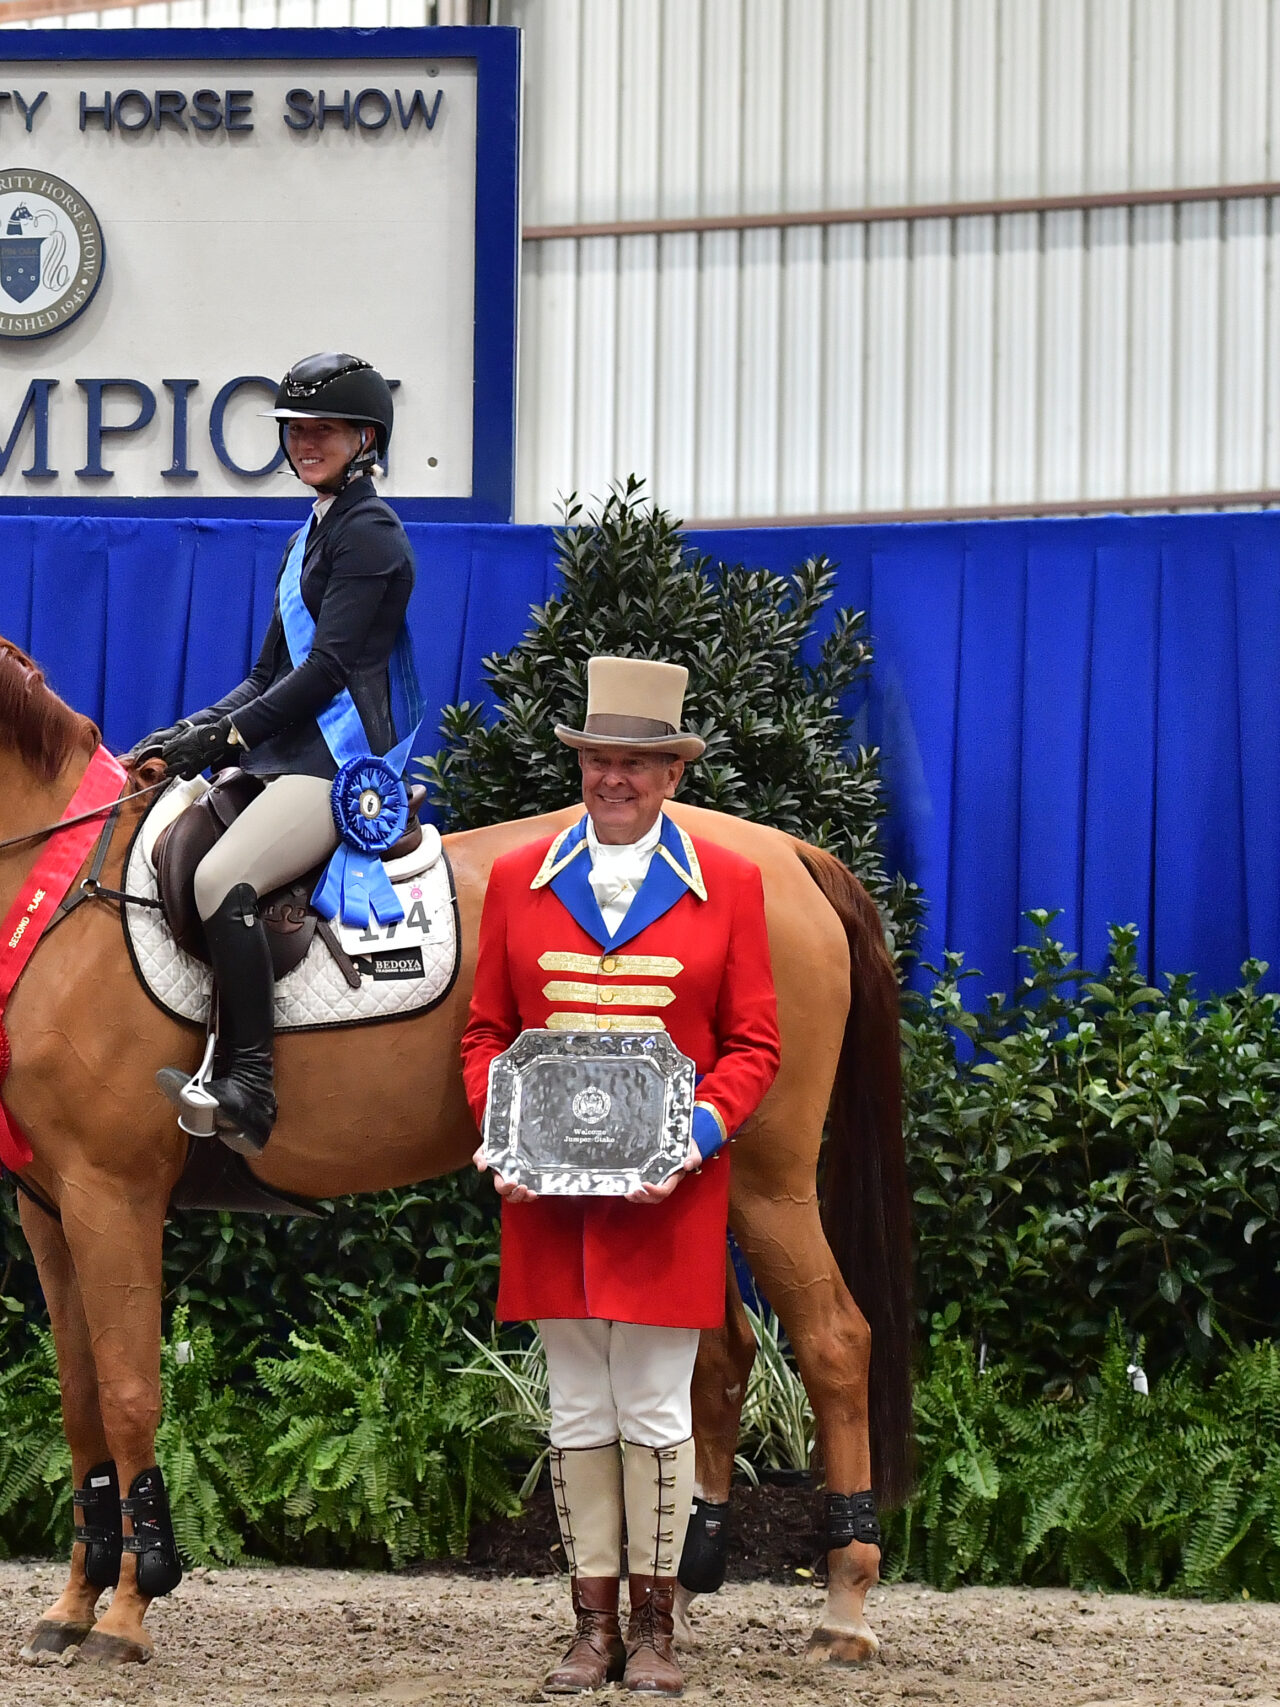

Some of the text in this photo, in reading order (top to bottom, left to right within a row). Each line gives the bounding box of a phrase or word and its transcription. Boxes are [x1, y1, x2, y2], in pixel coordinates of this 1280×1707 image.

[79, 88, 254, 132] HORSE
[283, 87, 444, 131] SHOW
[40, 180, 86, 222] HORSE
[80, 223, 96, 275] SHOW
[61, 287, 86, 315] 1945
[8, 888, 47, 949] SECOND PLACE
[375, 960, 421, 969] BEDOYA
